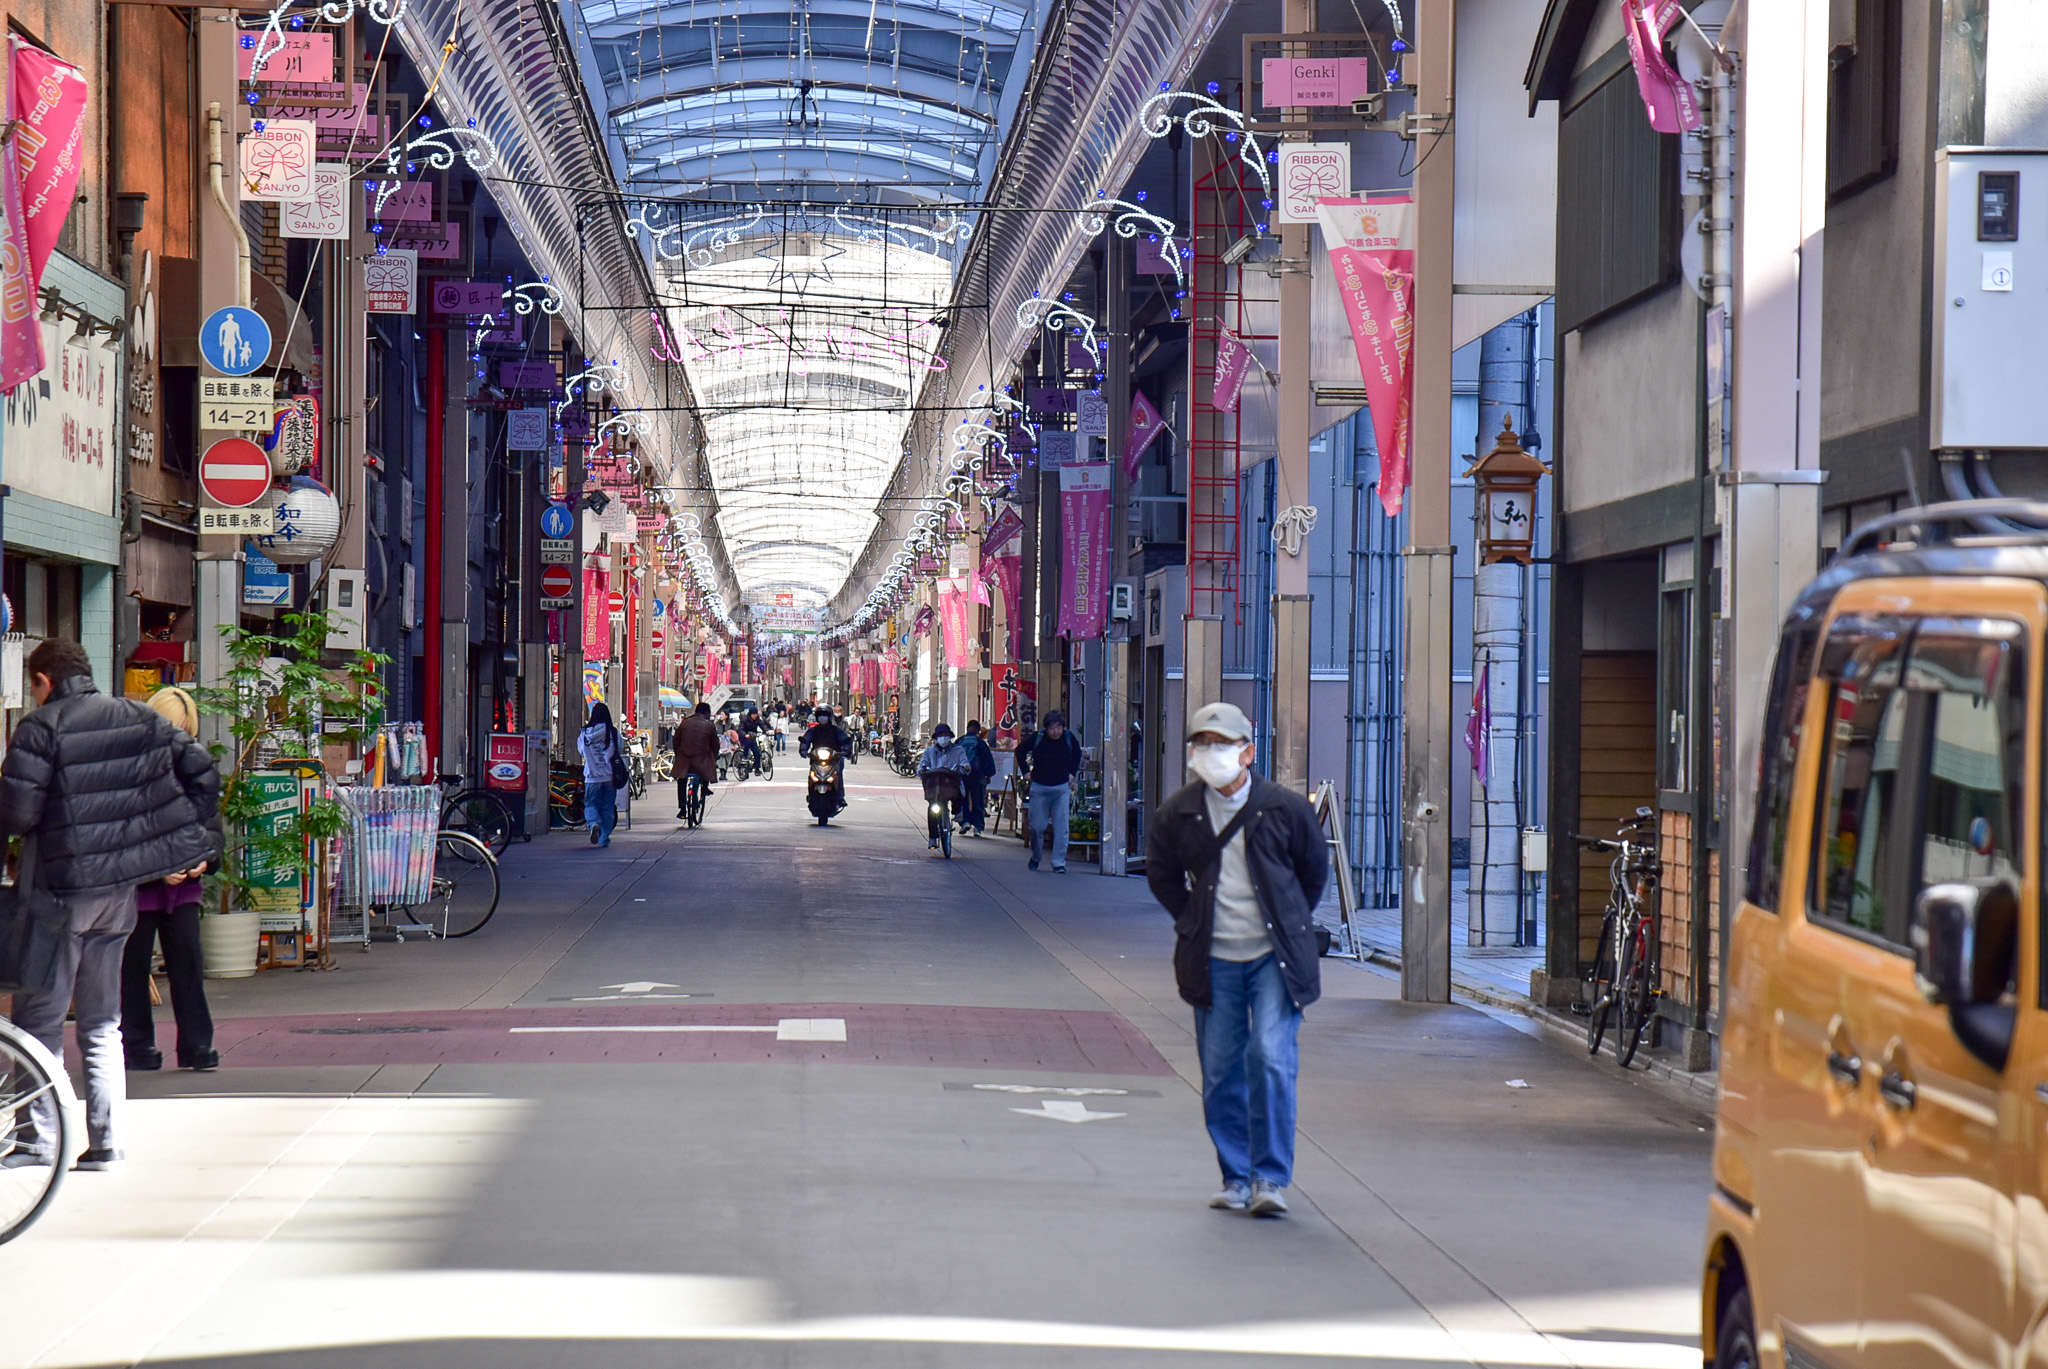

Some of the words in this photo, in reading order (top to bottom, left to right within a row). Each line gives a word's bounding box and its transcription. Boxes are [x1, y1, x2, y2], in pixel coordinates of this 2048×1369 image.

[1294, 64, 1336, 80] Genki
[254, 132, 302, 142] RIBBON
[1292, 155, 1337, 165] RIBBON
[315, 173, 337, 184] BON
[257, 182, 301, 193] SANJYO
[1294, 205, 1316, 214] SAN
[294, 221, 335, 231] SANJYO
[369, 258, 407, 267] RIBBON
[203, 382, 270, 398] 自転車を除く
[208, 410, 267, 425] 14-21
[203, 514, 270, 530] 自転車を除く
[637, 520, 661, 528] FRESCO
[264, 782, 296, 794] 市バス
